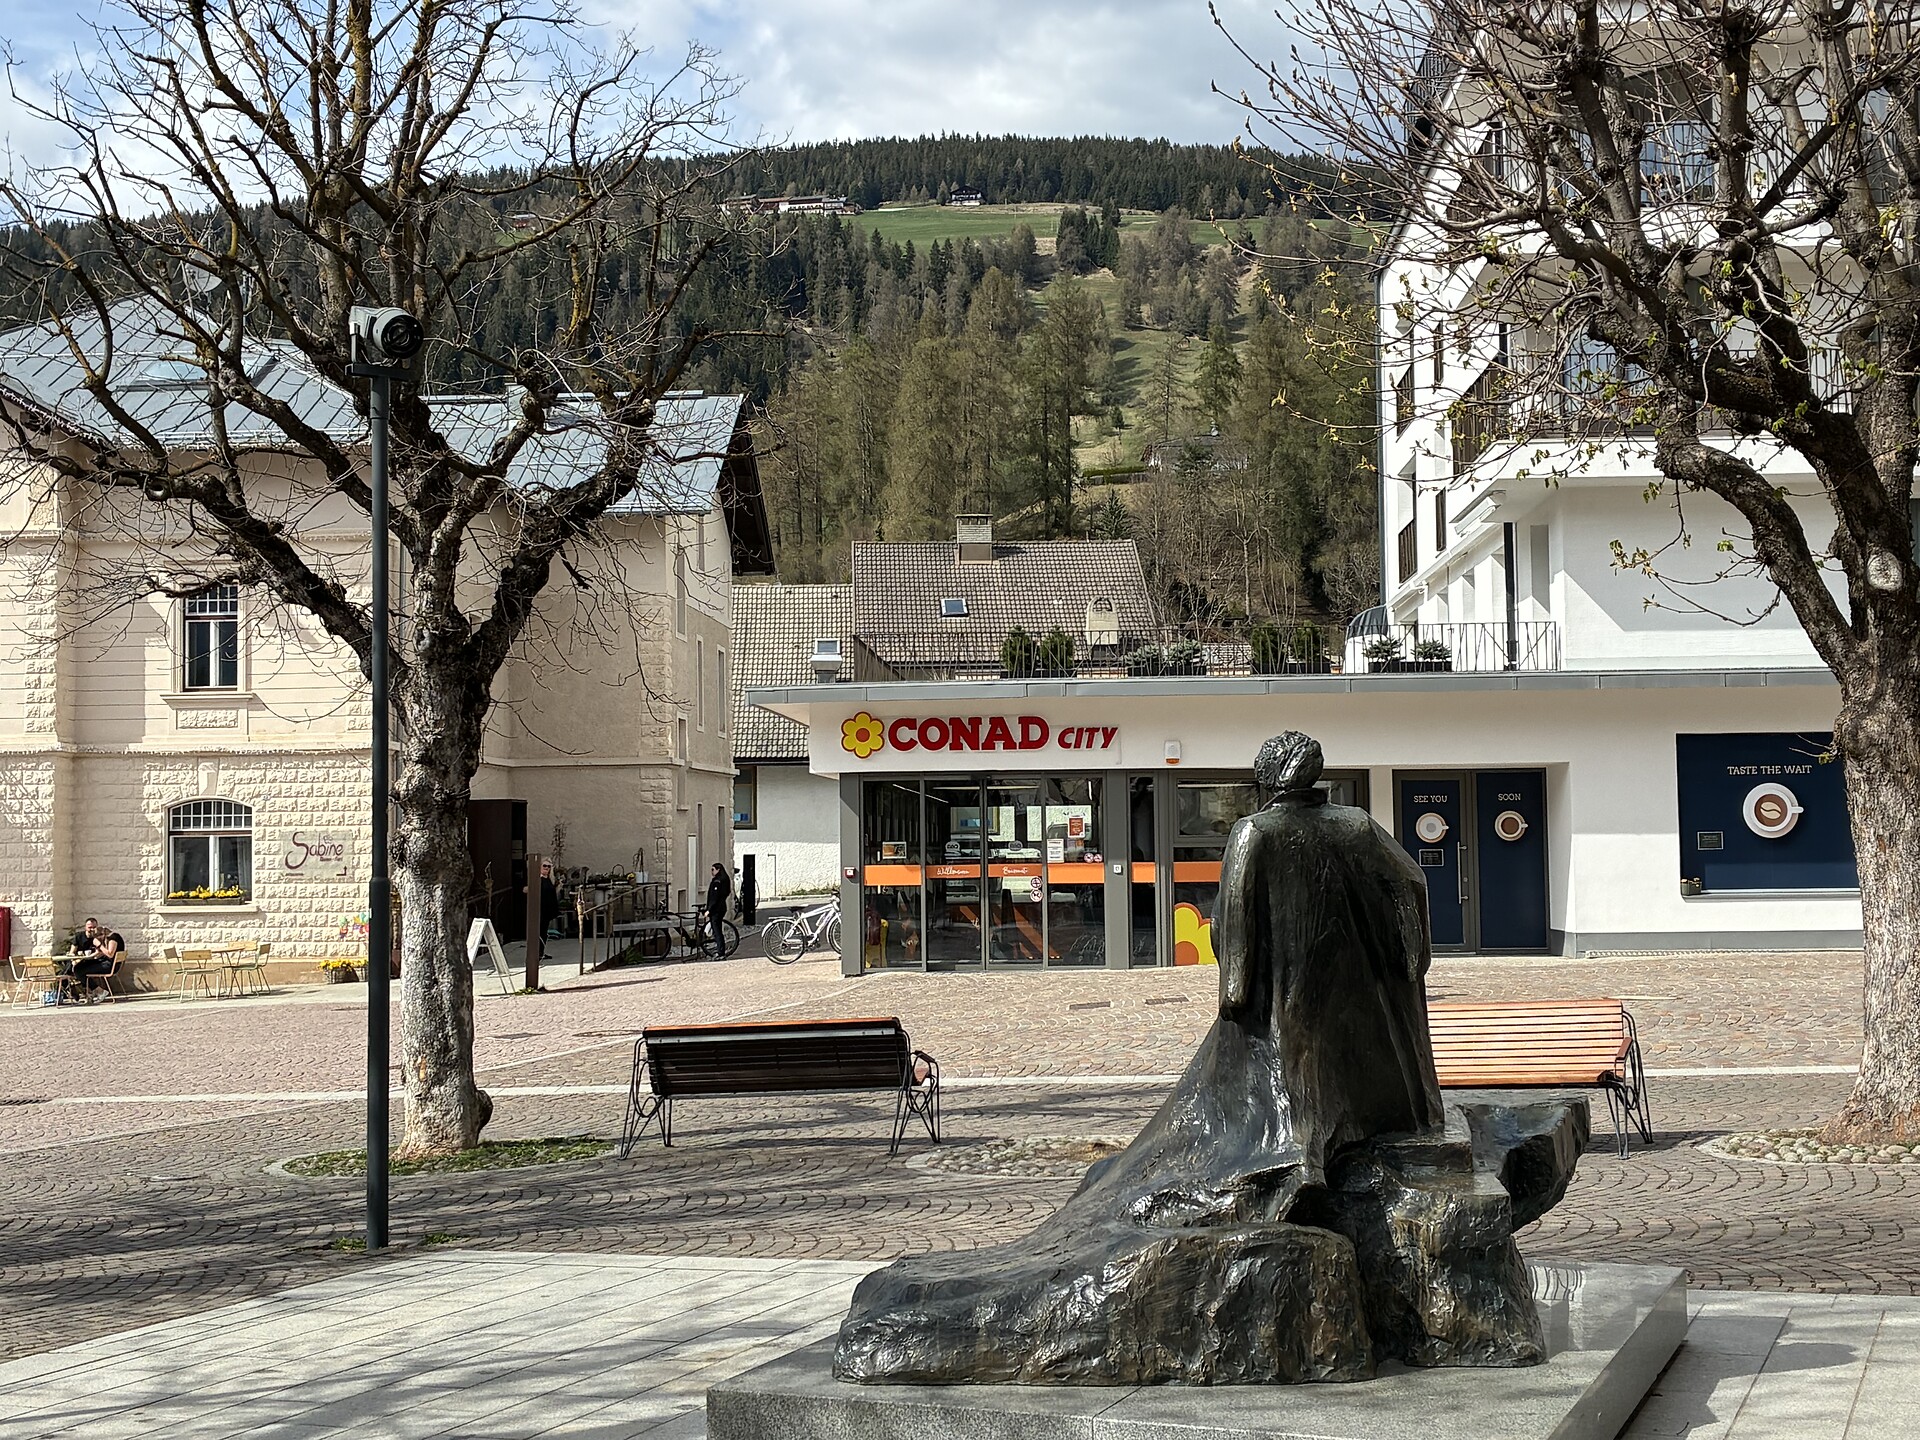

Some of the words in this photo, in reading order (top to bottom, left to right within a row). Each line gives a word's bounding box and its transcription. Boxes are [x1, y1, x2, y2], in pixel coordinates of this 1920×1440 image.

[888, 716, 1049, 751] CONAD
[1057, 726, 1118, 749] CITY
[1727, 766, 1758, 775] TASTE
[1760, 765, 1781, 774] THE
[1784, 765, 1812, 774] WAIT
[1413, 795, 1429, 803] SEE
[1430, 795, 1448, 803] YOU
[1497, 793, 1521, 801] SOON
[285, 831, 344, 869] Sabine
